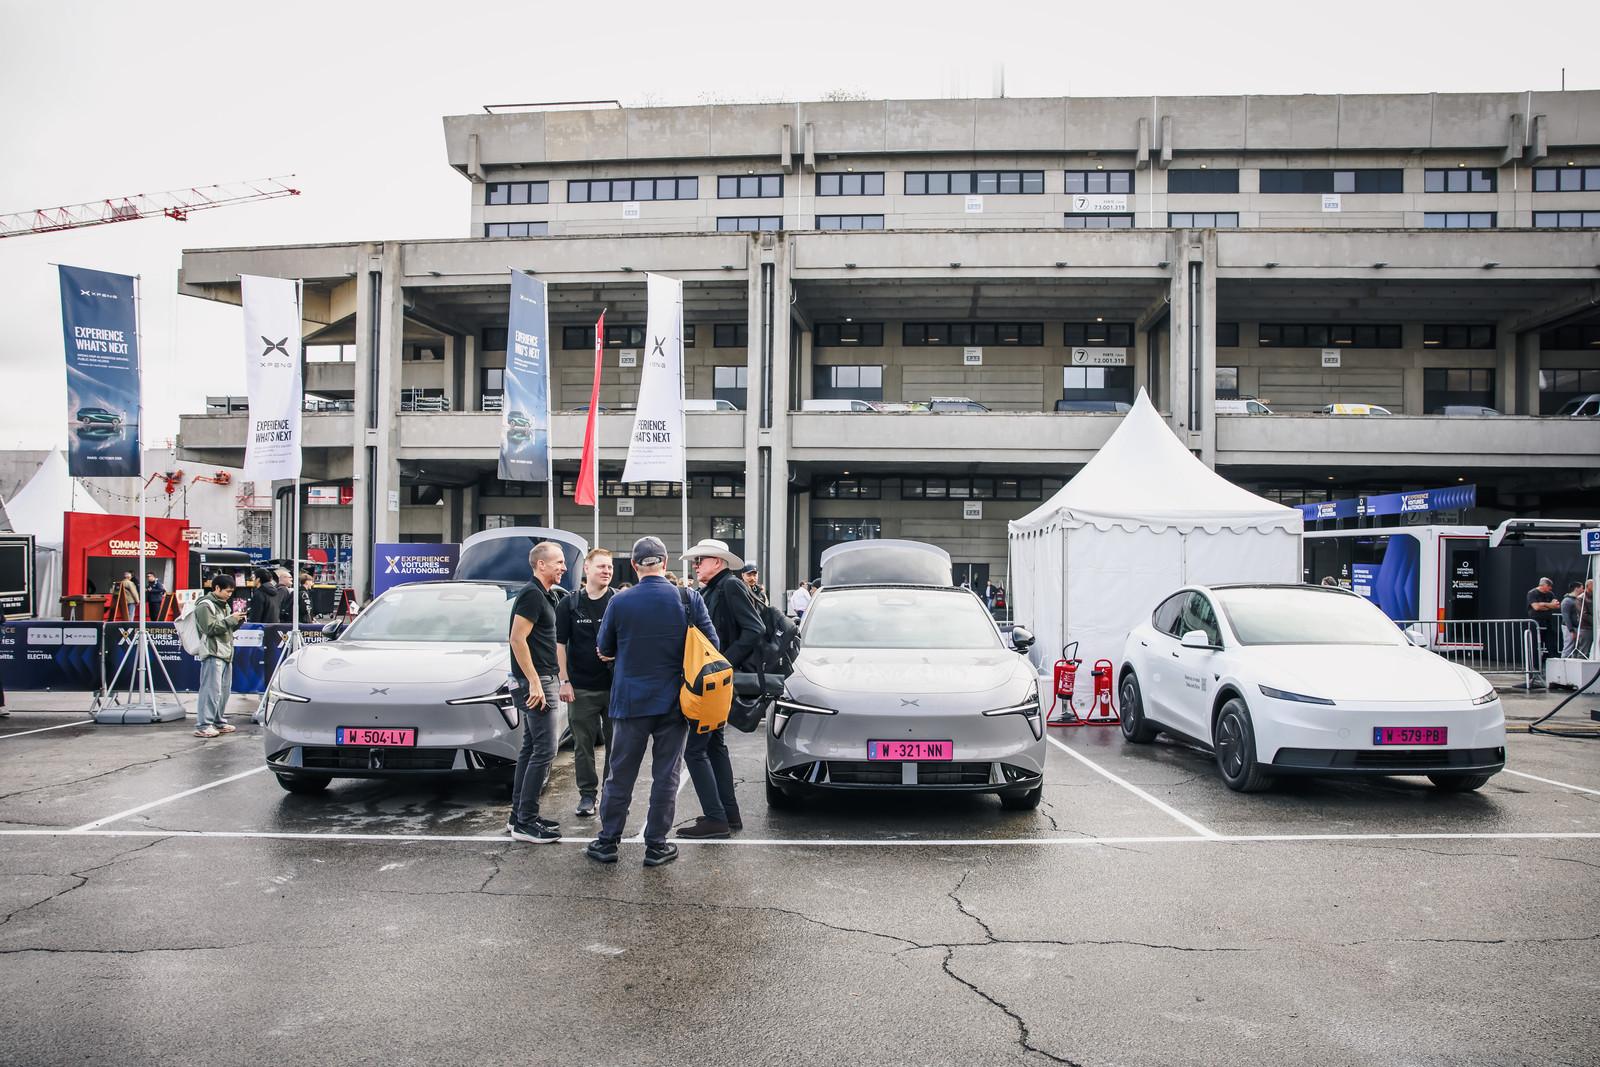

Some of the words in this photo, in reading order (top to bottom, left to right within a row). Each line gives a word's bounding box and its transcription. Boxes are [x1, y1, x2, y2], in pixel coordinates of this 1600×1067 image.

[74, 326, 125, 342] EXPERIENCE
[75, 338, 107, 352] WHAT'S
[109, 342, 129, 355] NEXT
[256, 419, 290, 432] EXPERIENCE
[276, 430, 293, 442] NEXT
[652, 432, 671, 443] NEXT
[109, 540, 159, 550] COMMADES
[401, 555, 450, 563] EXPERIENCE
